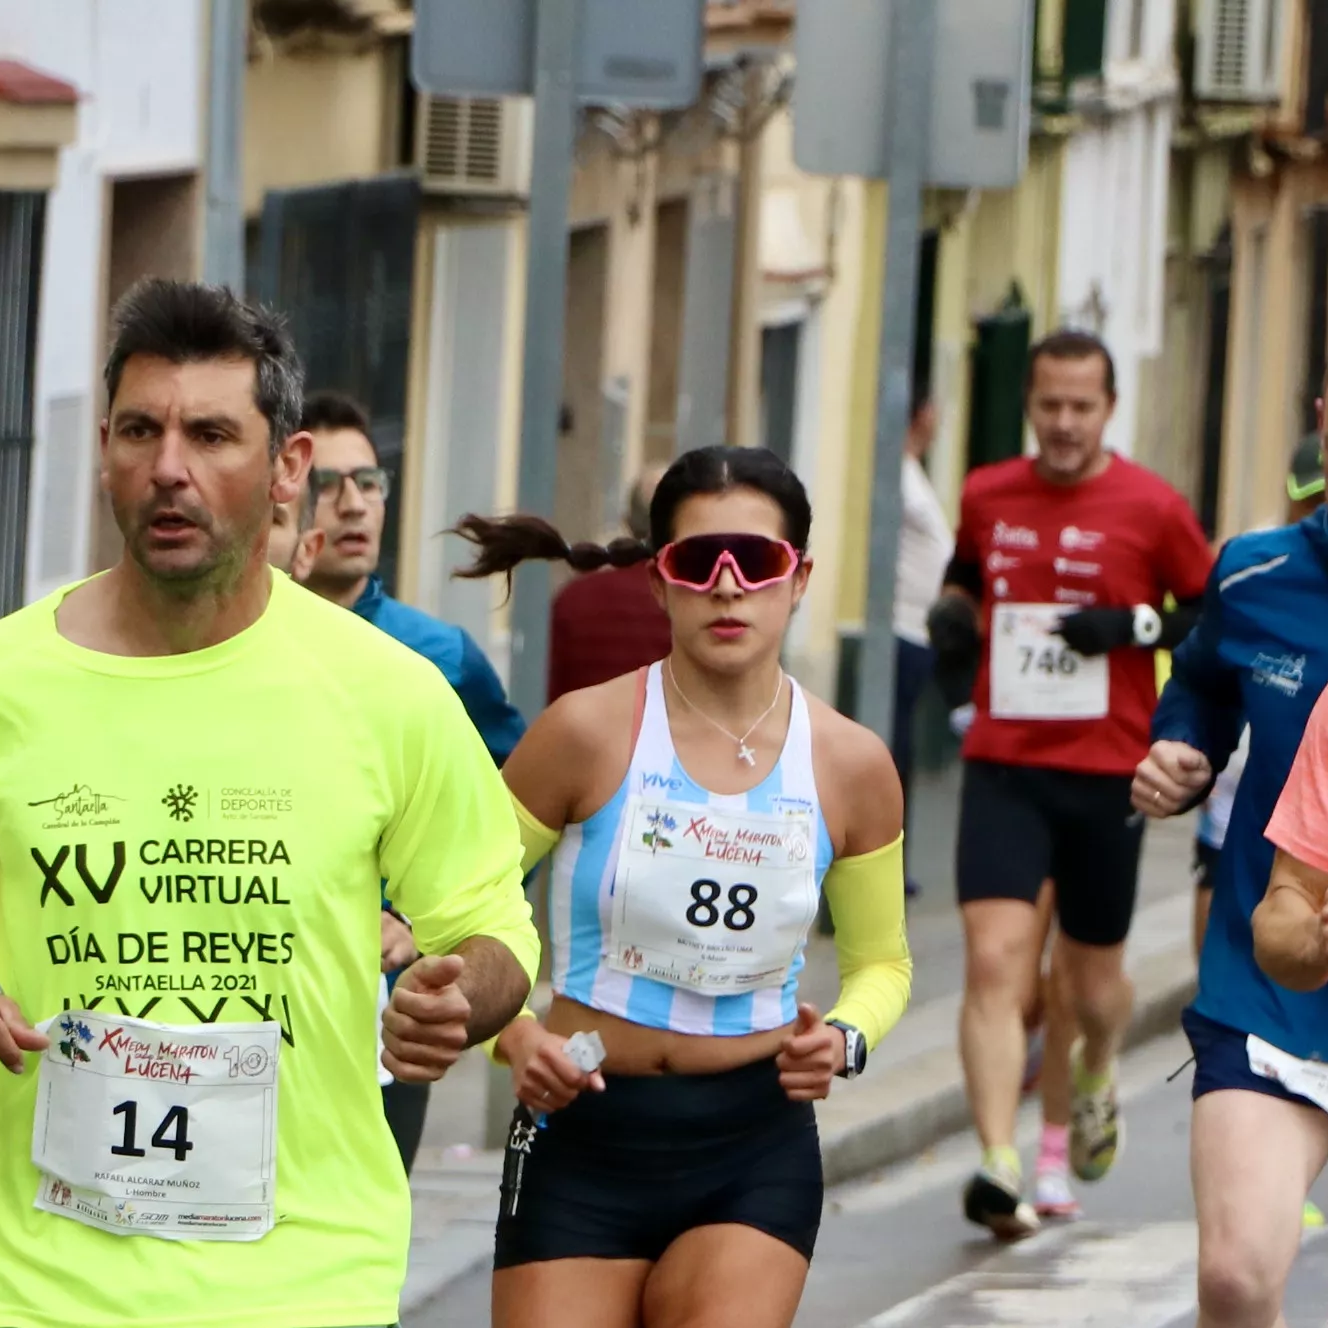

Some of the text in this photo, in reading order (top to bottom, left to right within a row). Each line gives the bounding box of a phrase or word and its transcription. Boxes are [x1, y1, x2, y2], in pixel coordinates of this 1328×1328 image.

[220, 799, 293, 811] DEPORTES
[281, 788, 292, 797] DE
[705, 841, 771, 866] LUCENA
[31, 839, 292, 908] XV CARRERA
[139, 875, 291, 905] VIRTUAL
[686, 878, 758, 931] 88
[46, 926, 296, 965] DÍA DE REYES
[95, 974, 257, 991] SANTAELLA 2021
[125, 1055, 201, 1084] LUCENA
[111, 1100, 194, 1161] 14
[94, 1172, 201, 1189] RAFAEL ALCARAZ MUÑOZ
[178, 1213, 262, 1222] mediamaratonlucena.com
